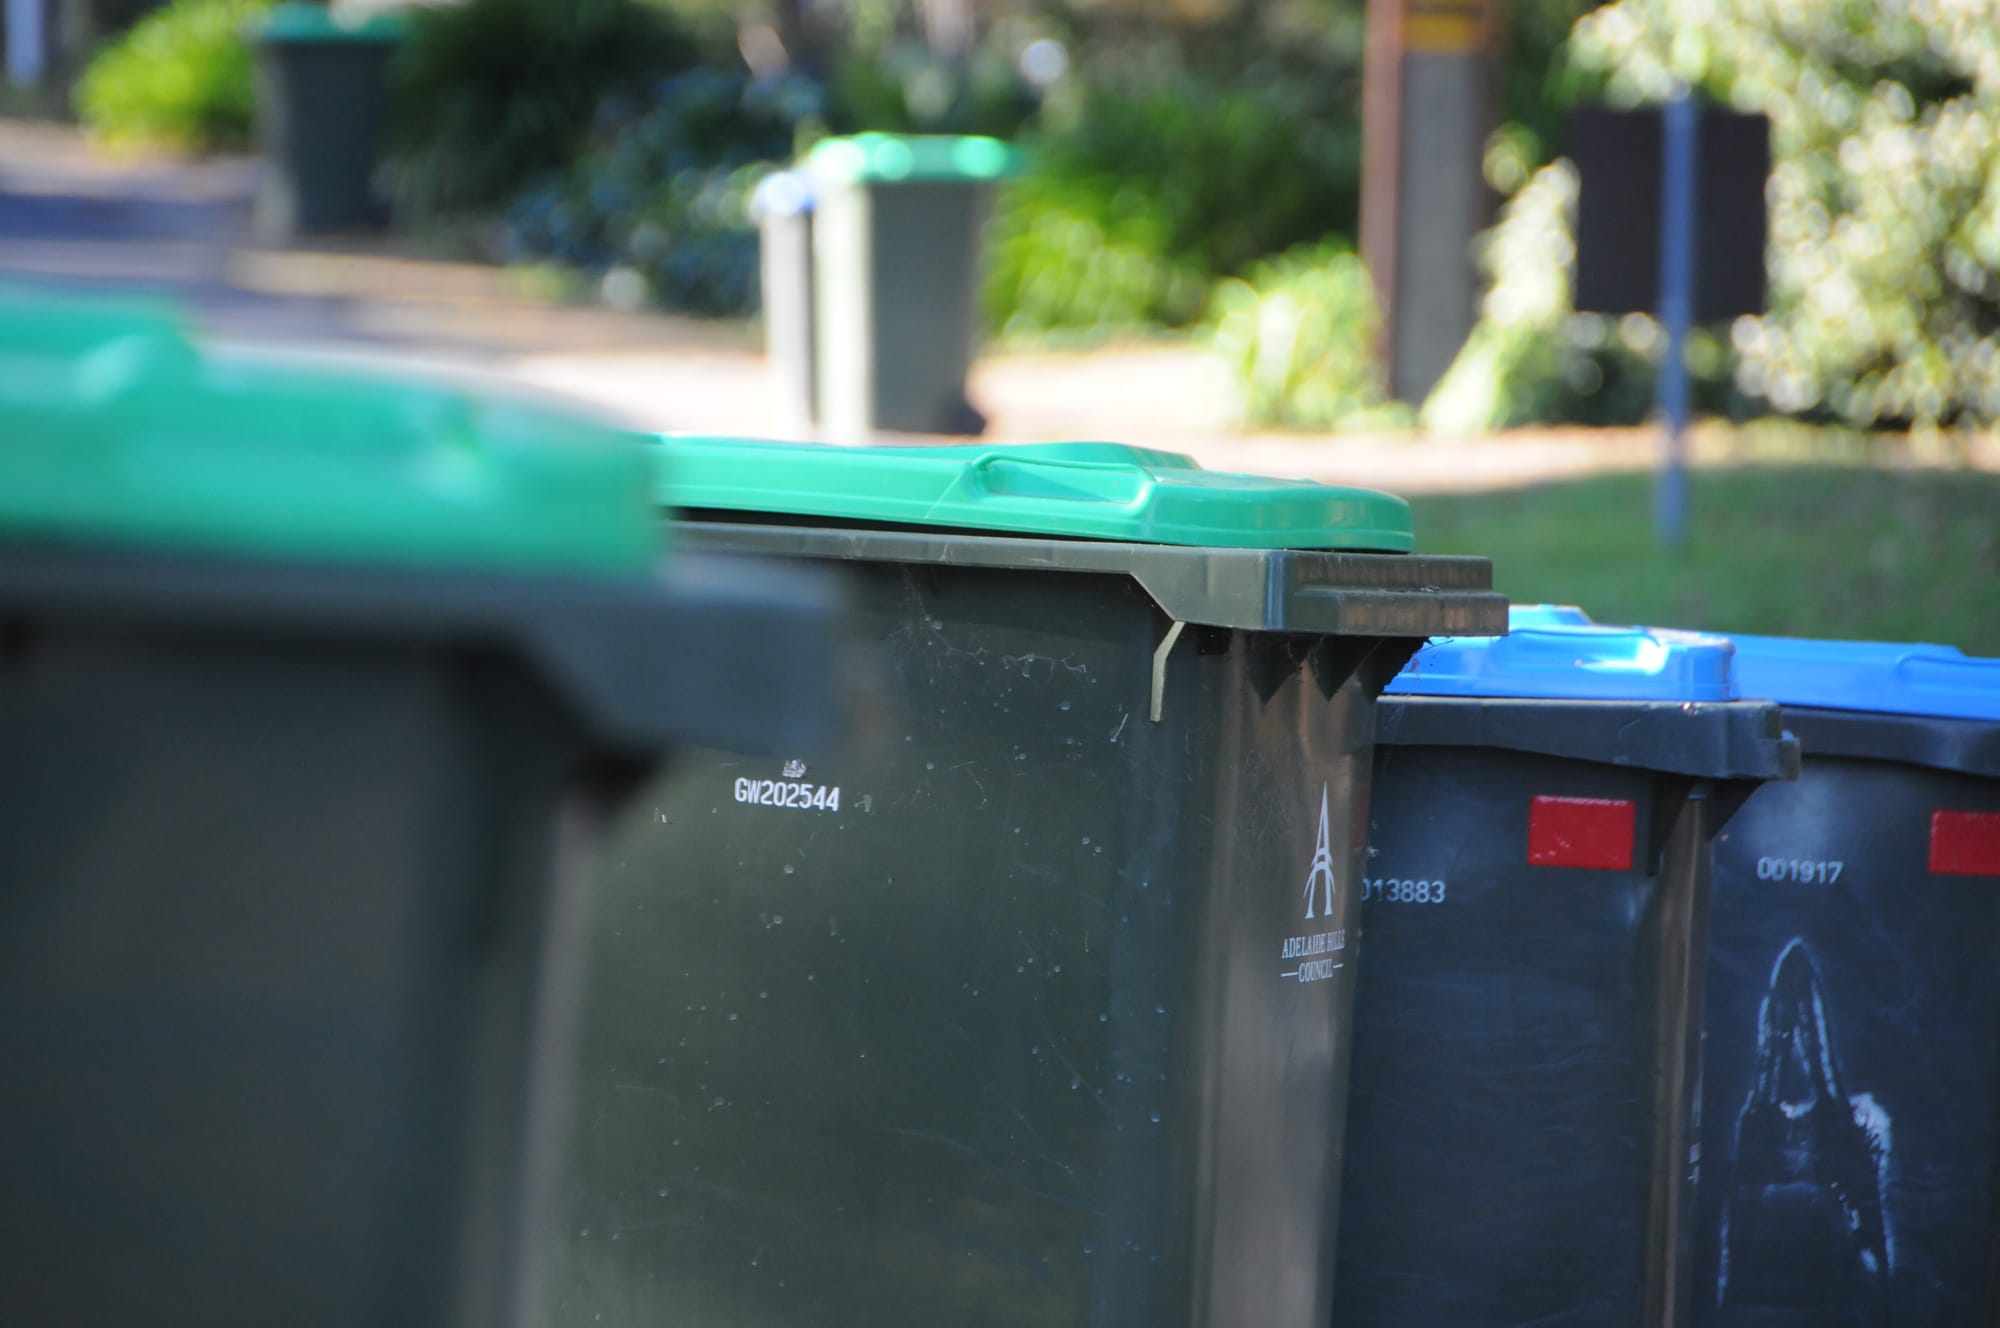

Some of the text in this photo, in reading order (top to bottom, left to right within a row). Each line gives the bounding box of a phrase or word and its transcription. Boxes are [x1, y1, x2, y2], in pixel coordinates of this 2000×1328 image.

[734, 777, 840, 812] GW202544
[1756, 856, 1844, 885] 001917
[1281, 933, 1326, 959] ADELAIDE
[1298, 959, 1334, 983] COUNCIL
